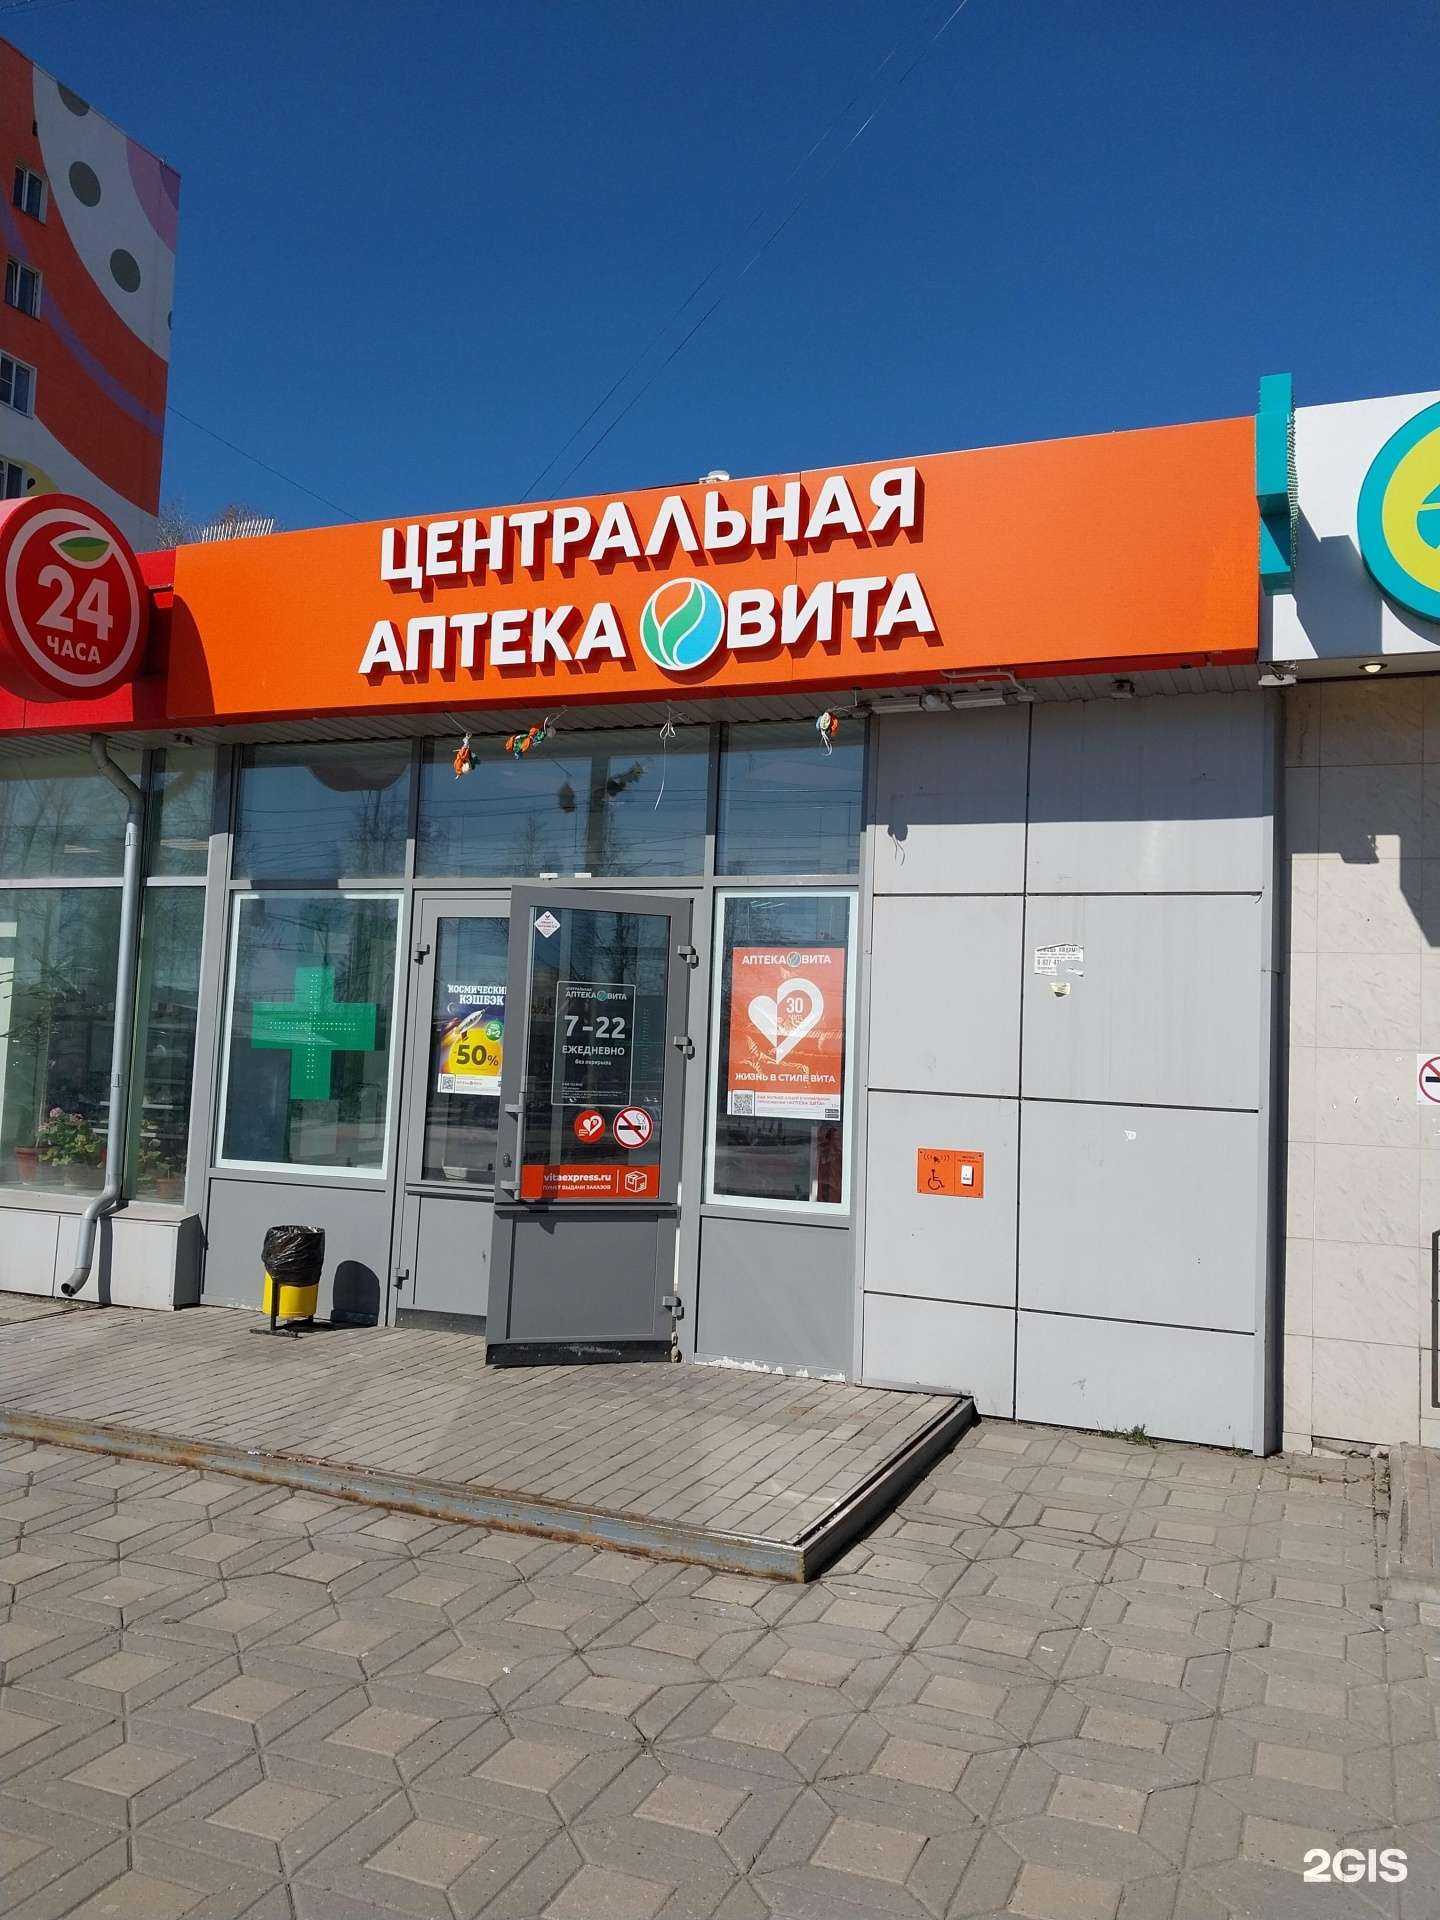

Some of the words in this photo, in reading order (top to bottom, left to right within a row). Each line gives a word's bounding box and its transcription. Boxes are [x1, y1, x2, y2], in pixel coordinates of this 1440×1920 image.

[380, 465, 918, 590] ЦЕНТРАЛЬНАЯ
[36, 564, 114, 641] 24
[357, 601, 627, 674] АПТЕКА
[725, 571, 936, 650] ВИТА
[46, 634, 101, 664] ЧАСА
[741, 954, 787, 965] АПТЕКА
[801, 953, 832, 964] ВИТА
[447, 984, 507, 996] КОСМИЧЕСКИ
[565, 990, 597, 1000] АПТЕКА
[607, 992, 627, 1001] ВИТА
[459, 994, 505, 1006] КЭШБЭК
[785, 997, 803, 1014] 30
[562, 1045, 626, 1057] ЕЖЕДНЕВНО
[735, 1072, 769, 1081] ЖИЗНЬ
[770, 1072, 777, 1081] В
[778, 1073, 810, 1082] СТИЛЕ
[811, 1074, 836, 1083] ВИТА
[543, 1172, 612, 1183] vitaexpress.ru
